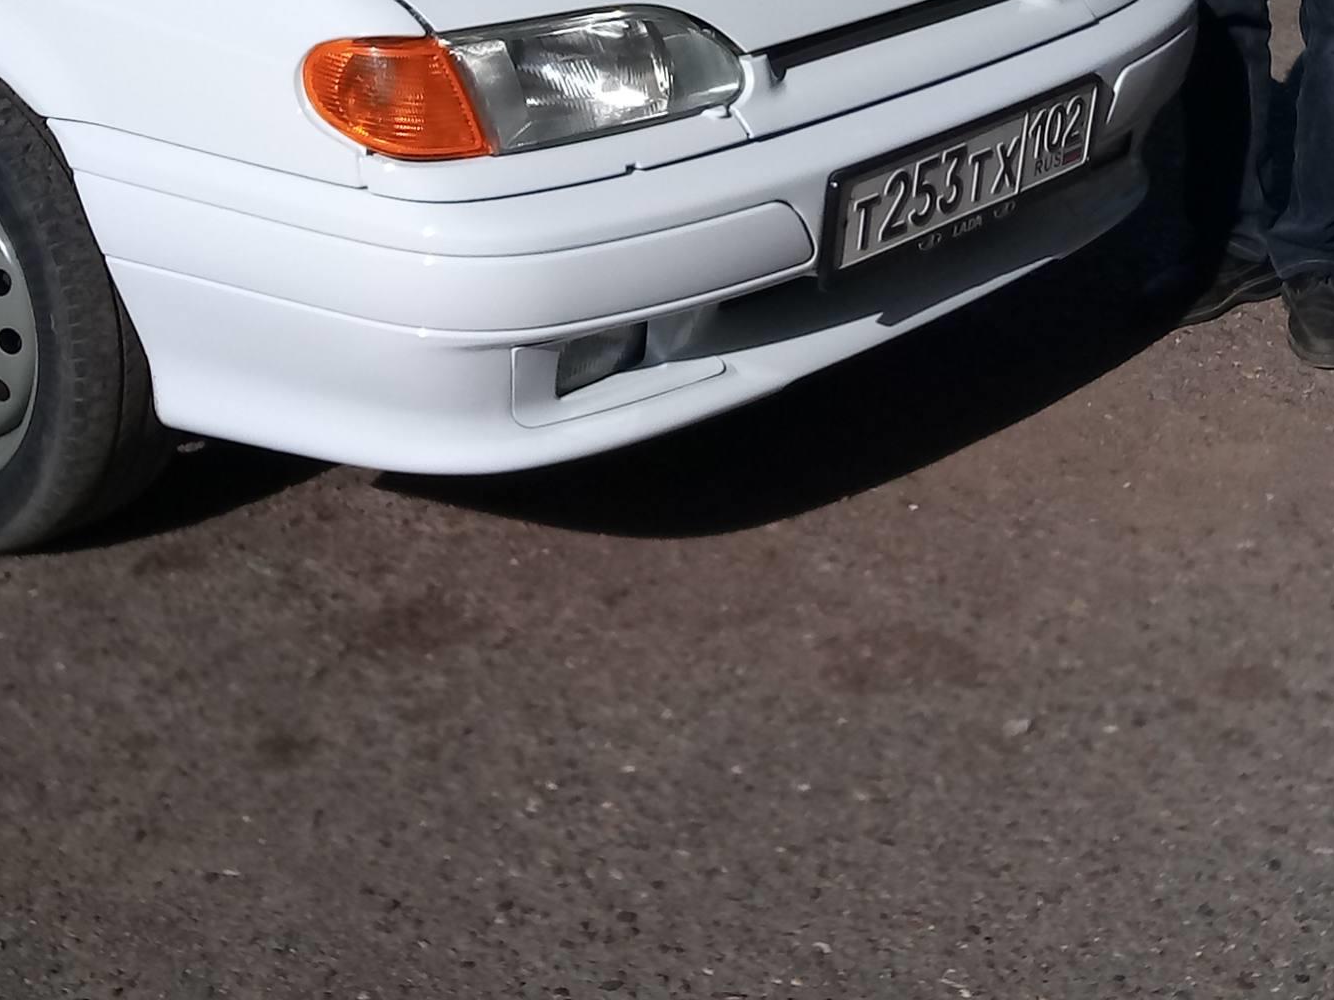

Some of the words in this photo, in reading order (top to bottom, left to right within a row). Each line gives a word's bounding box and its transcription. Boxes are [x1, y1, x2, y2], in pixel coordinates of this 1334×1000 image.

[1028, 95, 1086, 159] 102
[1034, 154, 1064, 177] RUS
[952, 214, 984, 238] LADA
